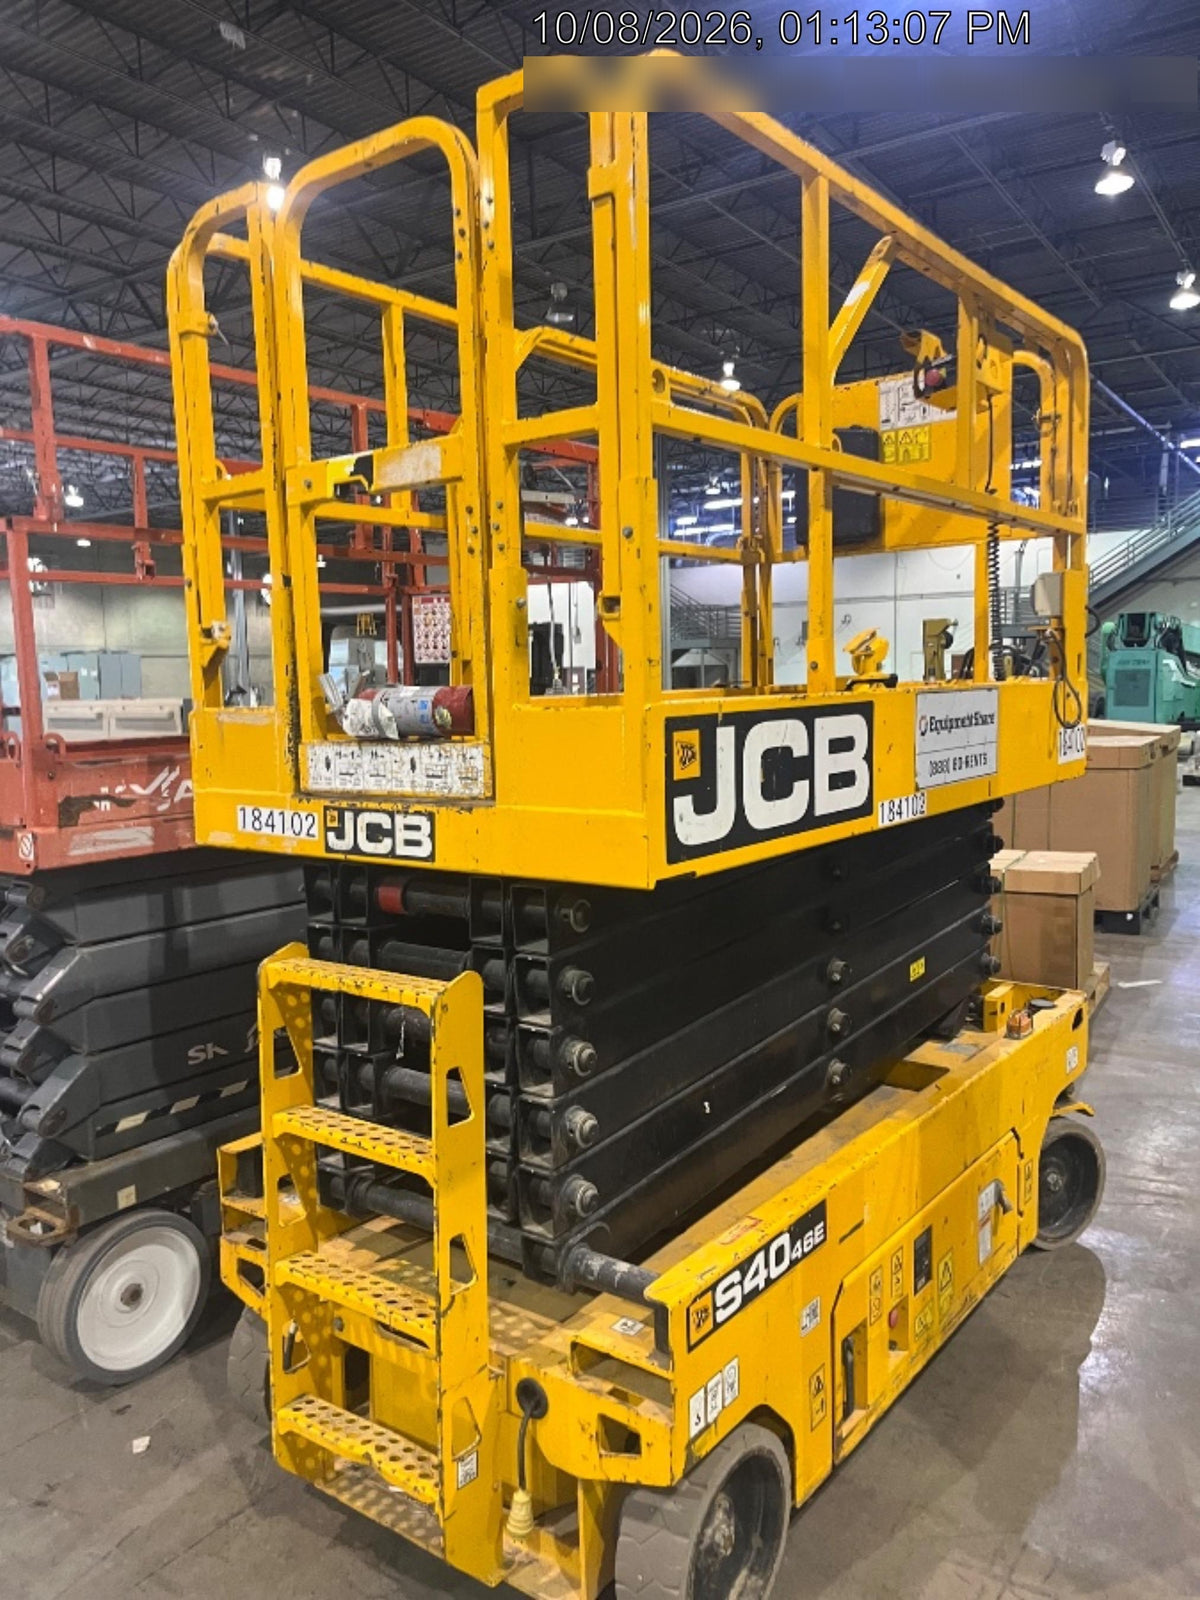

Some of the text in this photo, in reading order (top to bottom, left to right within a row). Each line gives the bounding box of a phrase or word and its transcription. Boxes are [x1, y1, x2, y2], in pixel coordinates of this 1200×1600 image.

[673, 714, 870, 845] JCB
[239, 807, 316, 838] 184102
[880, 792, 926, 824] 184102
[327, 811, 433, 858] JCB
